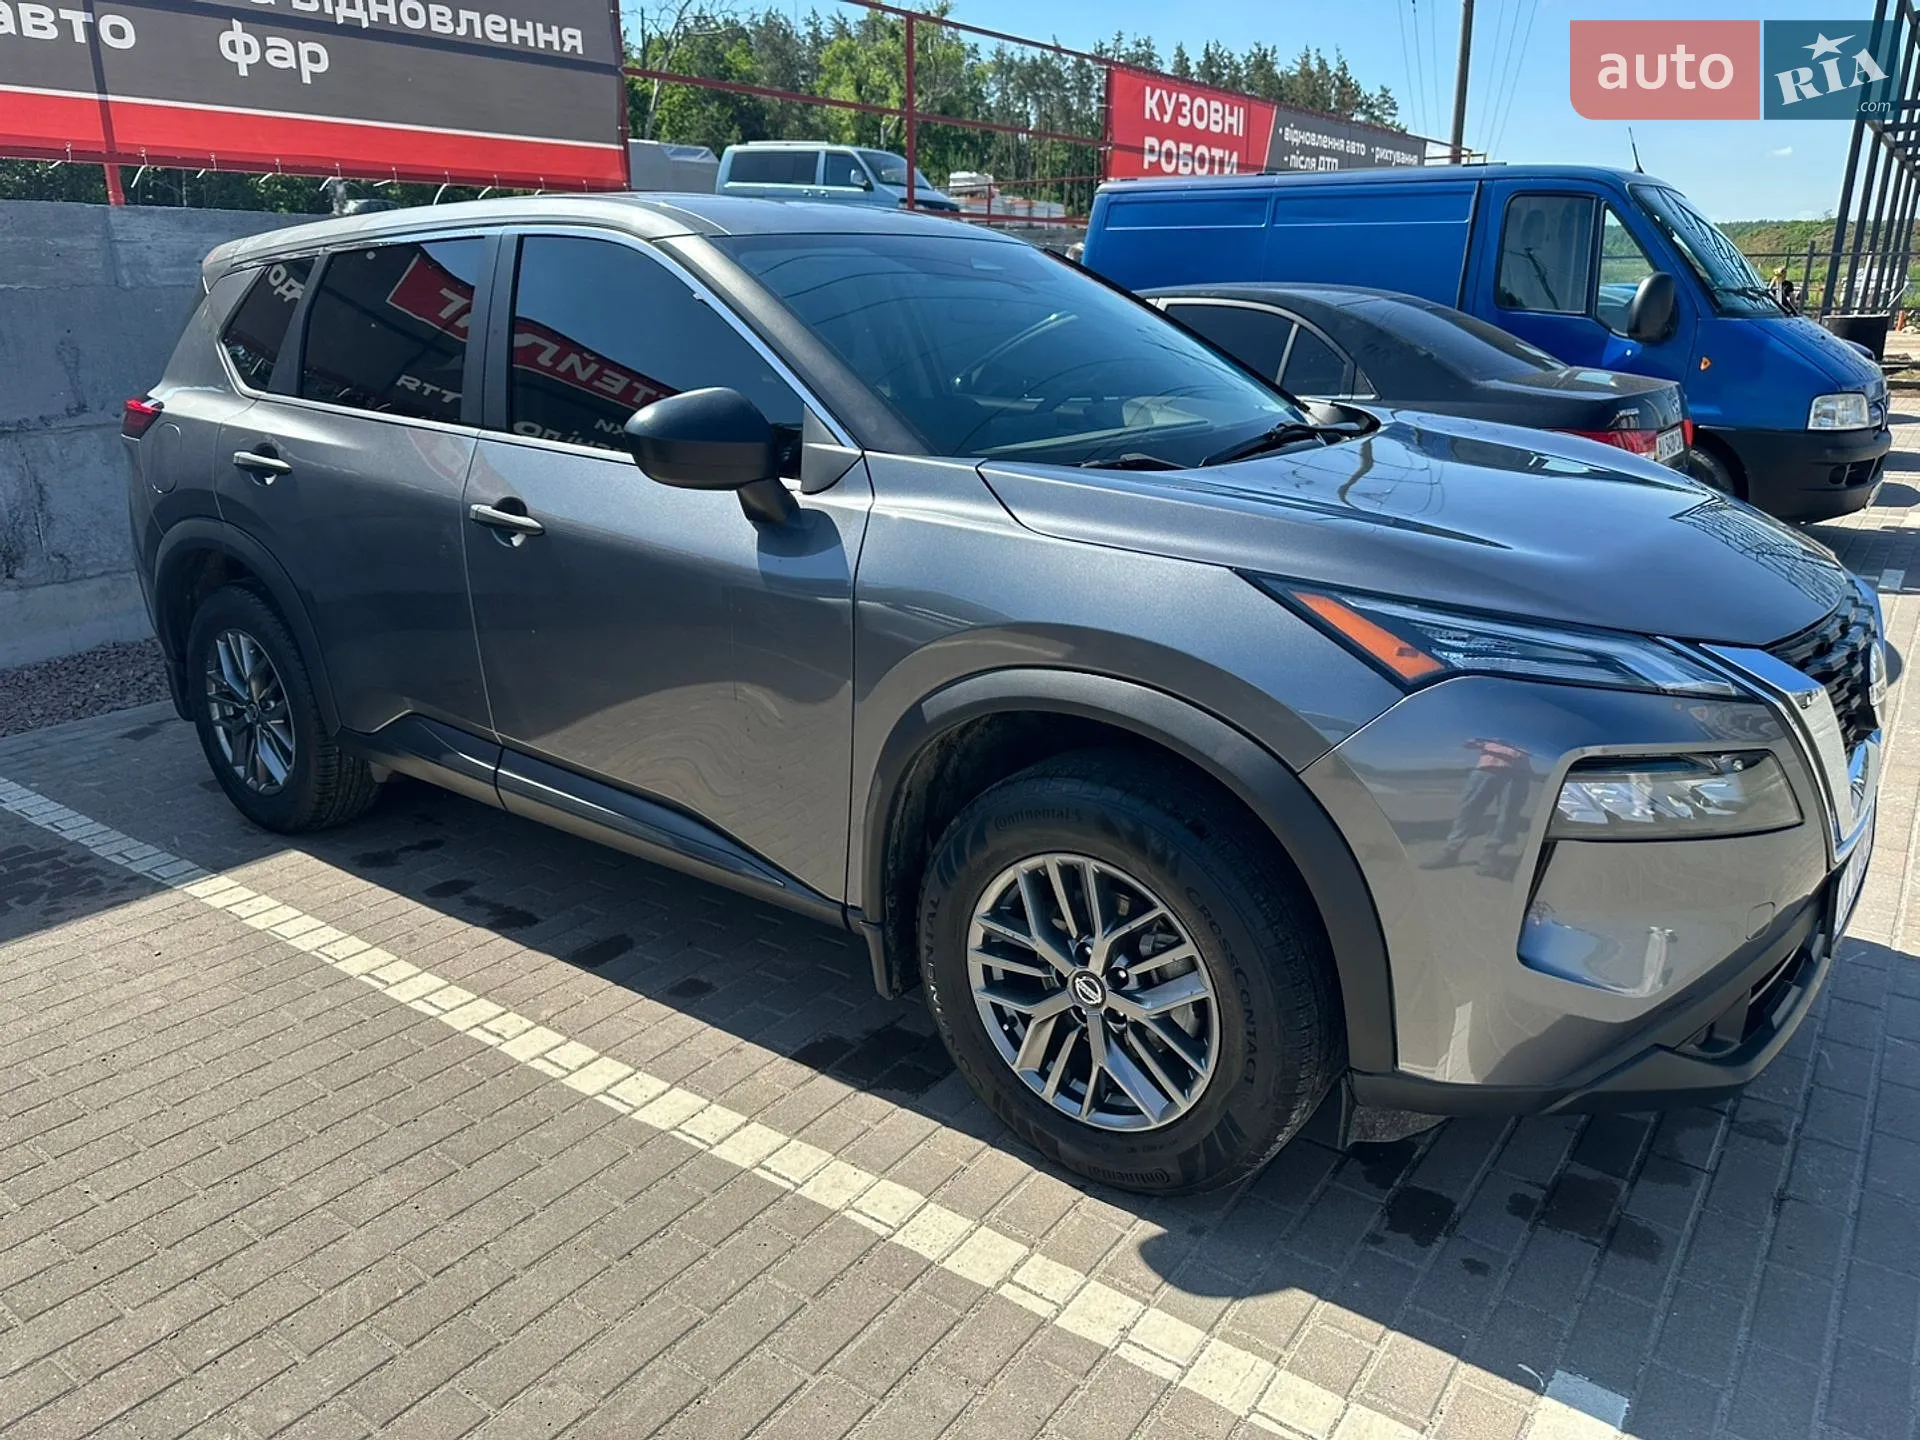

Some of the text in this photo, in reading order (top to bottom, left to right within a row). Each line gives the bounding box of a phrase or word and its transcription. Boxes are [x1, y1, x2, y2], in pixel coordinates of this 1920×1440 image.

[219, 18, 329, 84] фар
[1144, 86, 1244, 137] КУЗОВНІ
[1143, 136, 1238, 175] РОБОТИ
[1284, 123, 1366, 156] відновлення авто
[1374, 146, 1418, 167] рихтування
[1289, 151, 1339, 170] після ДТП
